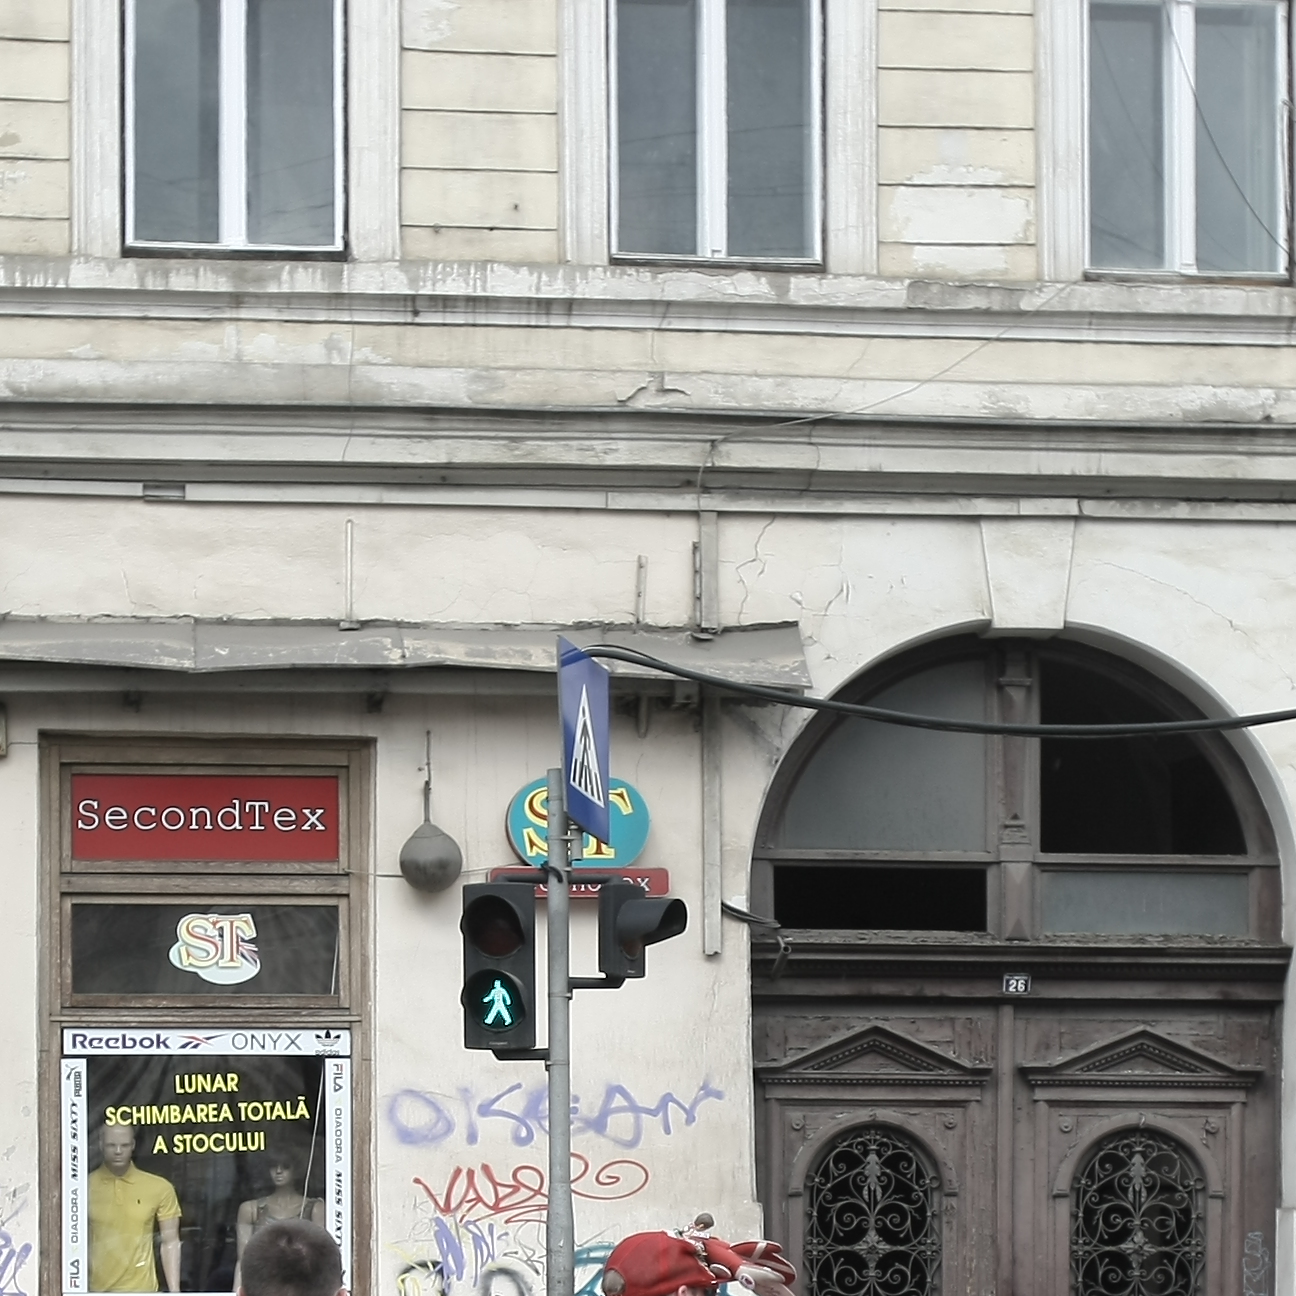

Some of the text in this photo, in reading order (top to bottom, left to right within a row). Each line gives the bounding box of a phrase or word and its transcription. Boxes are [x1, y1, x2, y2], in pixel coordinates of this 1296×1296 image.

[77, 799, 326, 831] SecondTex
[177, 914, 257, 968] ST
[1009, 979, 1026, 992] 26
[71, 1032, 303, 1051] Reebok ONYX
[175, 1073, 240, 1094] LUNAR
[332, 1063, 344, 1093] FILA
[105, 1104, 234, 1126] SCHIMBAREA
[70, 1098, 79, 1181] SIXTY MISS
[153, 1132, 265, 1154] A STOCULUI
[334, 1107, 343, 1248] DIADORA MISS SIXT
[70, 1187, 79, 1244] DIADORA
[69, 1258, 80, 1289] FILA
